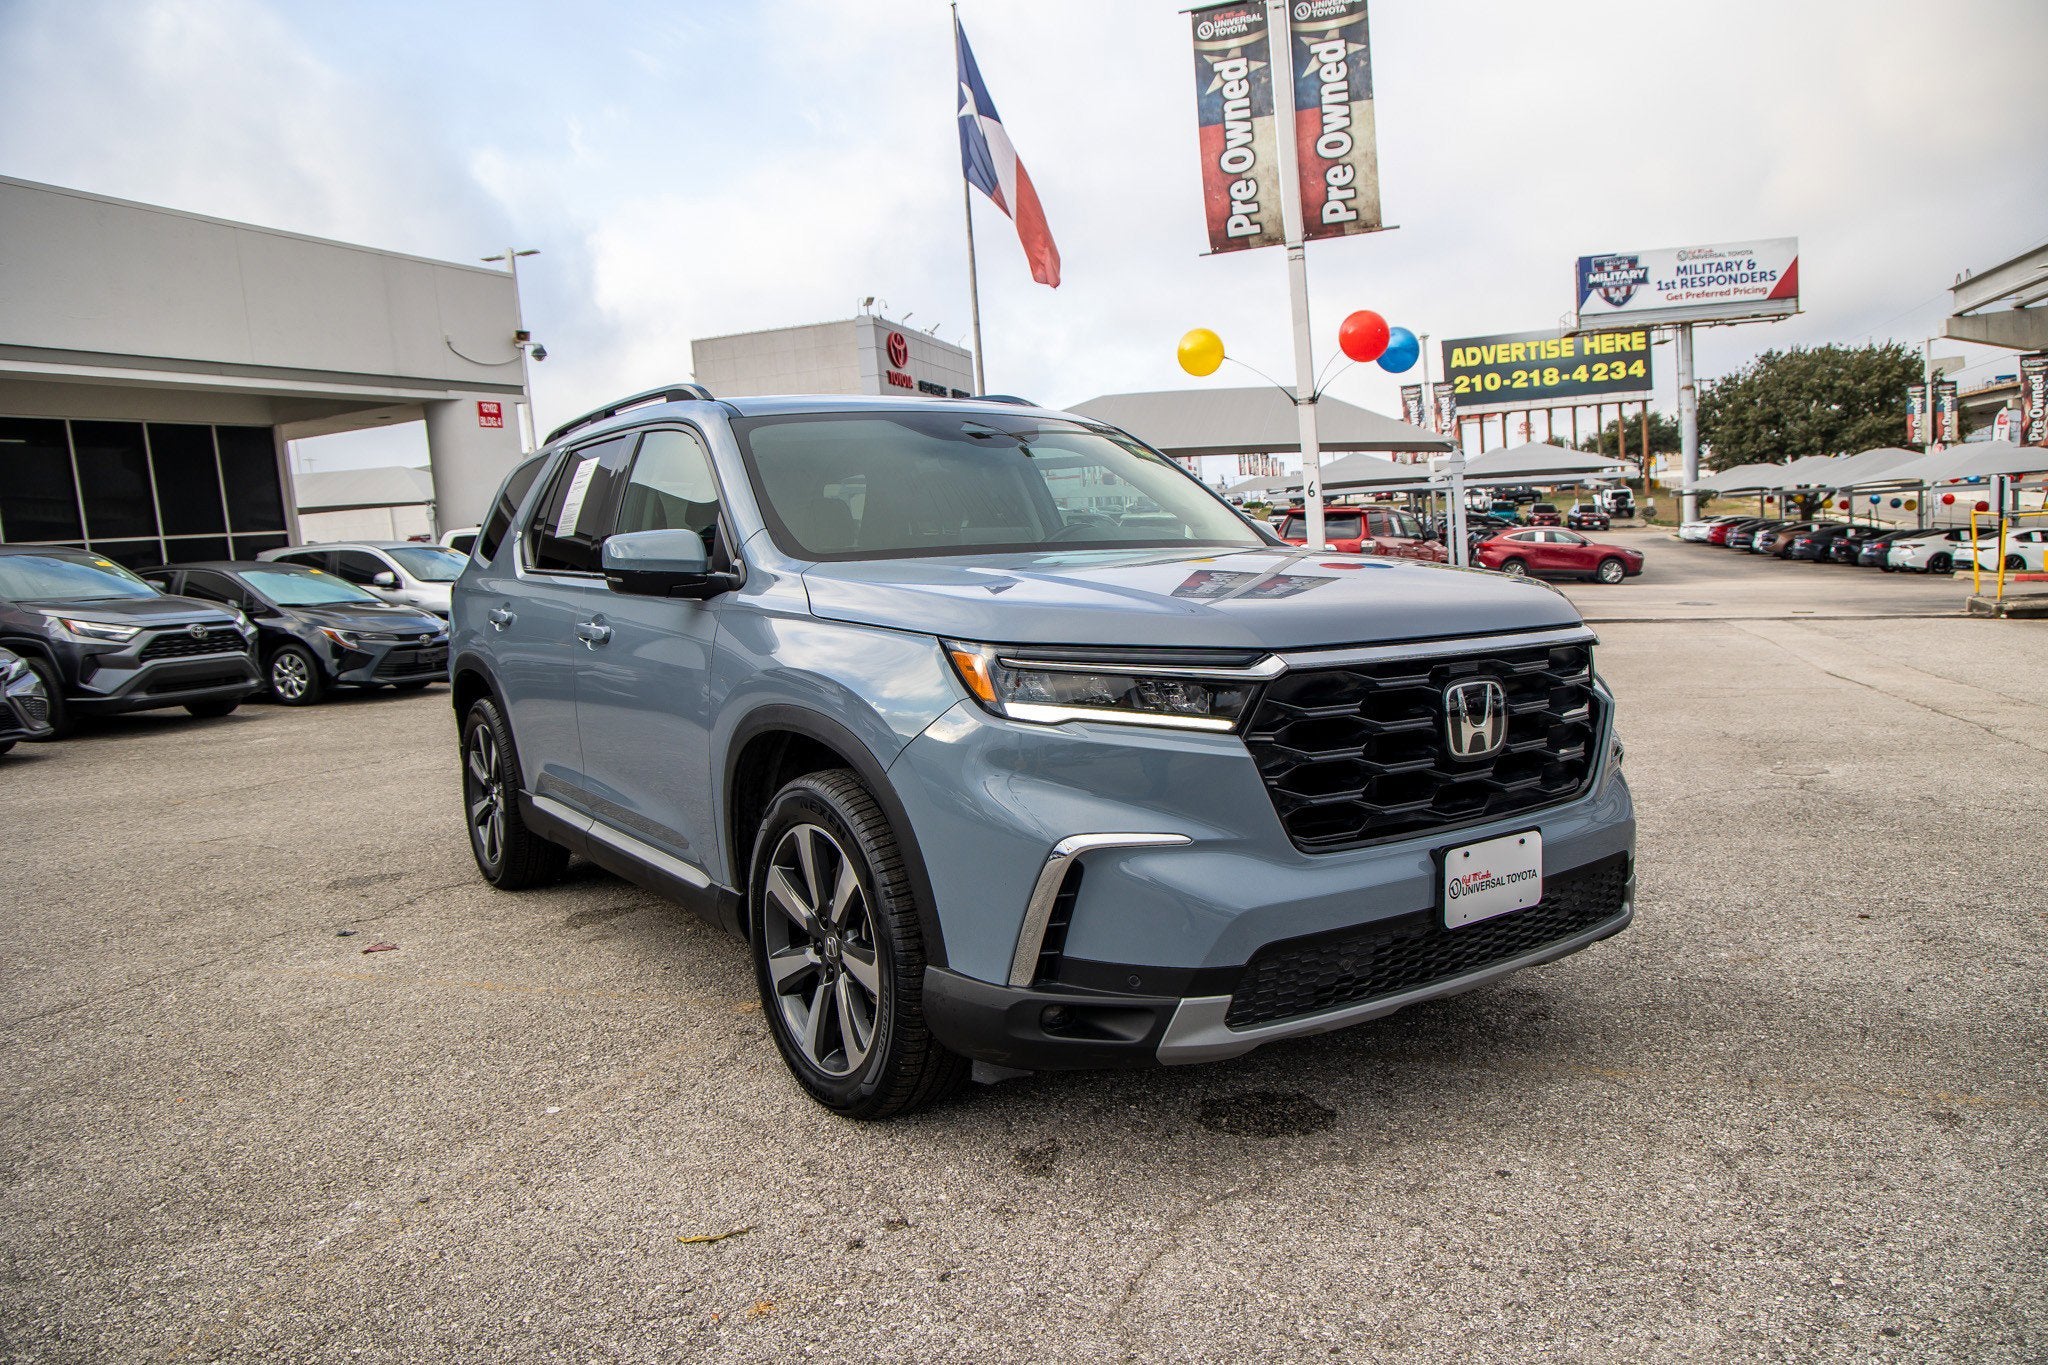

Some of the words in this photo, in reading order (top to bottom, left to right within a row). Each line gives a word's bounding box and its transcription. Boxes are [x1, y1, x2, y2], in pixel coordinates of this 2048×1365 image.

[1214, 13, 1263, 28] UNIVERSAL
[1312, 4, 1346, 18] TOYOTA
[1215, 24, 1248, 37] TOYOTA
[1310, 39, 1352, 159] Owned
[1213, 57, 1255, 174] Owned
[1322, 164, 1357, 224] Pre
[1227, 178, 1261, 238] Pre
[1588, 268, 1646, 284] MILITARY
[1676, 260, 1743, 276] MILITARY
[1747, 259, 1756, 270] &
[1657, 279, 1677, 291] 1st
[1680, 270, 1777, 289] RESPONDERS
[1666, 292, 1683, 301] Get
[1685, 288, 1731, 299] Preferred
[1734, 286, 1767, 295] Pricing
[1450, 337, 1575, 368] ADVERTISE
[1583, 331, 1647, 356] HERE
[1454, 359, 1646, 394] 210-218-4234
[2028, 374, 2044, 418] Owned
[2028, 421, 2044, 442] Pre
[1308, 481, 1315, 497] 6
[800, 797, 847, 841] NEXEN
[1461, 876, 1505, 896] UNIVERSAL
[1506, 869, 1537, 885] TOYOTA
